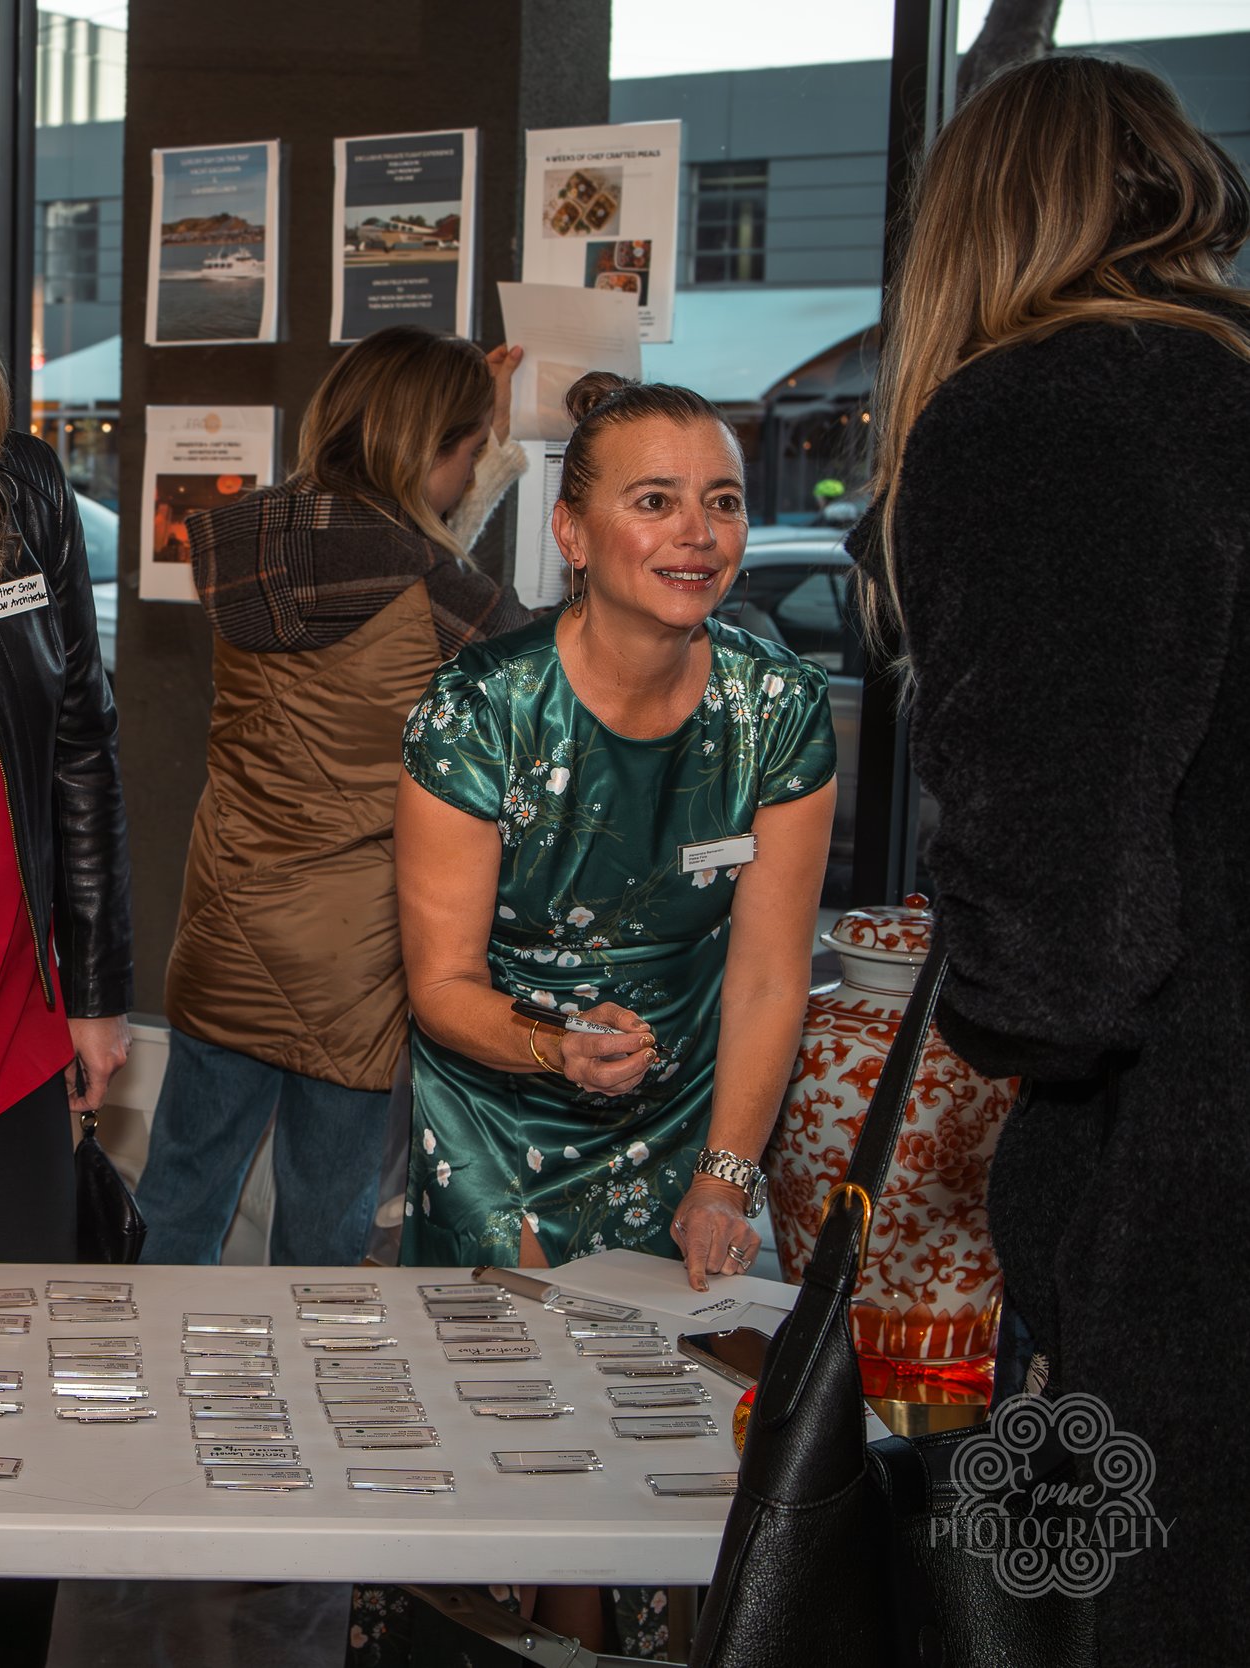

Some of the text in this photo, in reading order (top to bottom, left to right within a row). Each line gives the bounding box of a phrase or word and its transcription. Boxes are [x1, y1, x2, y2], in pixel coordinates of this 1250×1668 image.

[551, 154, 575, 162] WEEKS
[586, 152, 604, 160] CHEF
[605, 151, 637, 160] CRAFTED
[637, 149, 661, 158] MEALS
[18, 581, 38, 594] Snow
